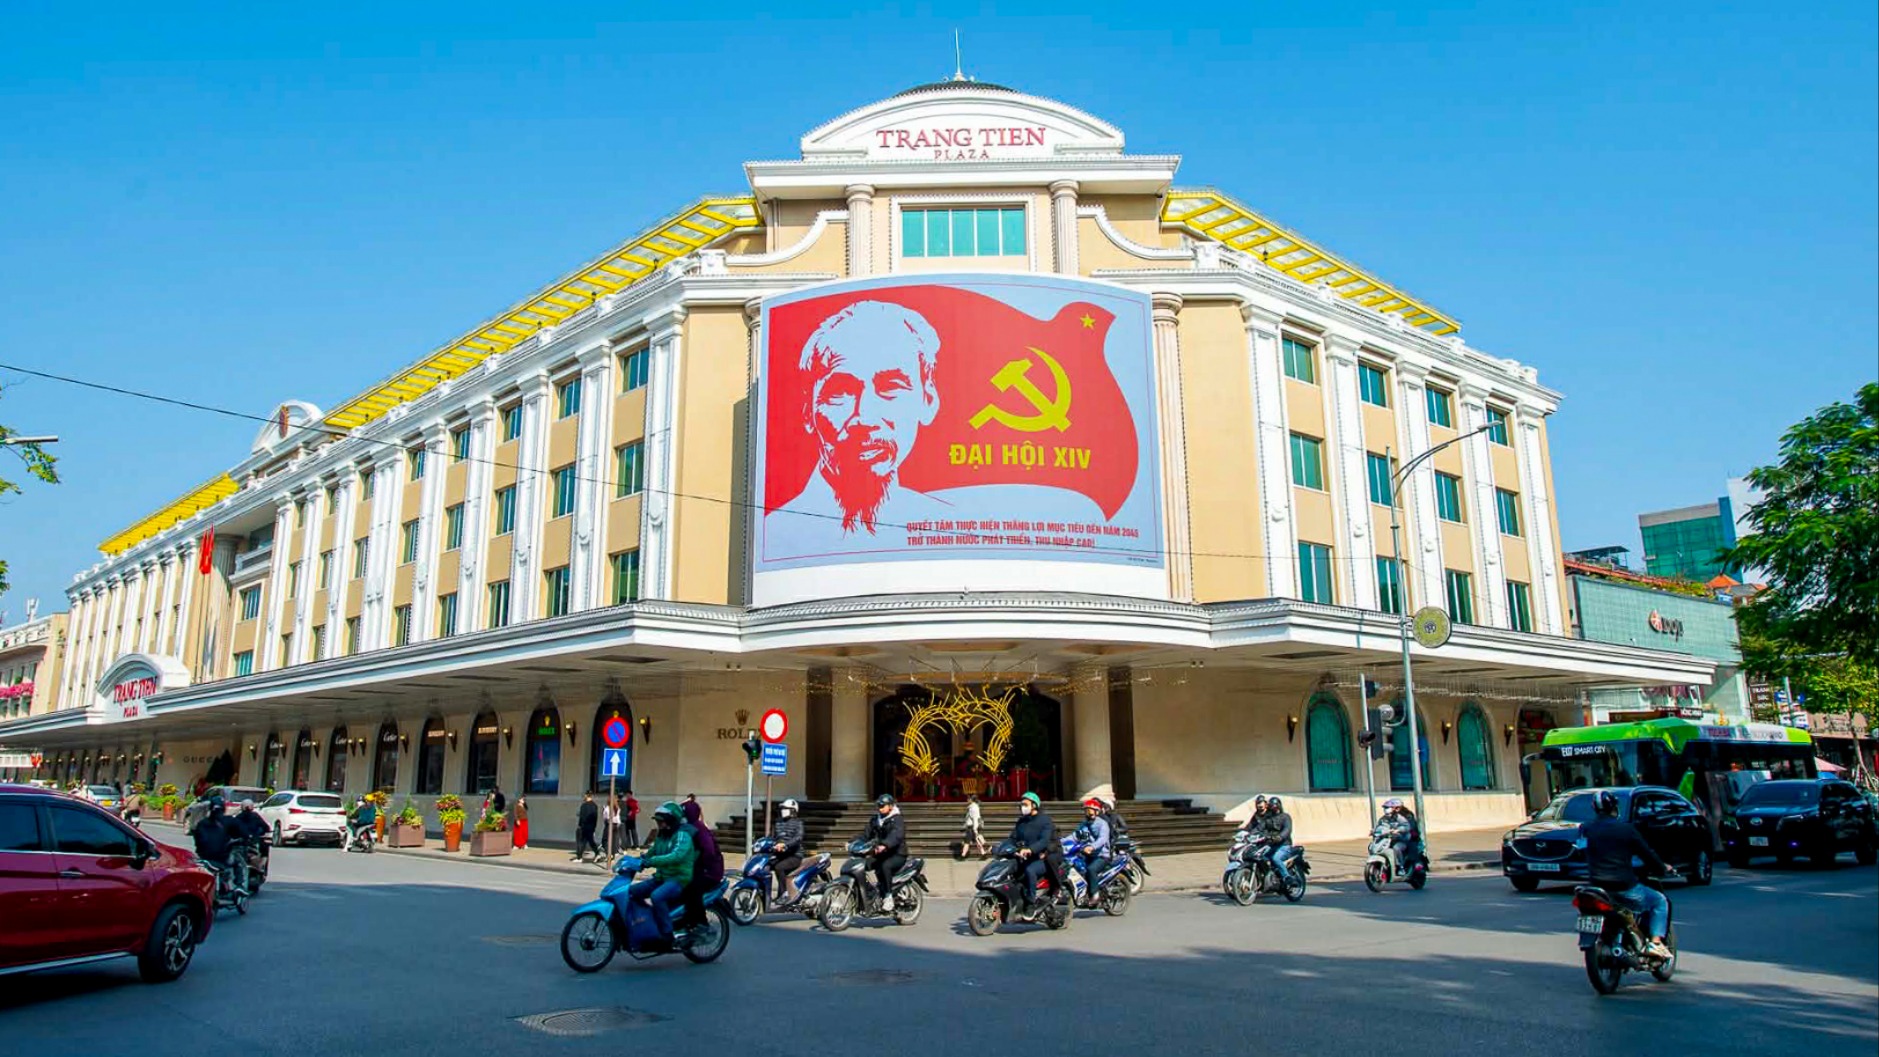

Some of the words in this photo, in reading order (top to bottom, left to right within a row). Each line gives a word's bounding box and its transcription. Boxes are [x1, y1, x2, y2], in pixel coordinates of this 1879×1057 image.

[876, 128, 972, 150] TRANG
[978, 127, 1046, 147] TIEN
[934, 149, 990, 159] PLAZA
[948, 443, 993, 470] ĐẠI
[1002, 440, 1046, 470] HỘI
[1053, 446, 1091, 469] XIV
[717, 727, 761, 740] ROL
[183, 756, 214, 764] GUCC
